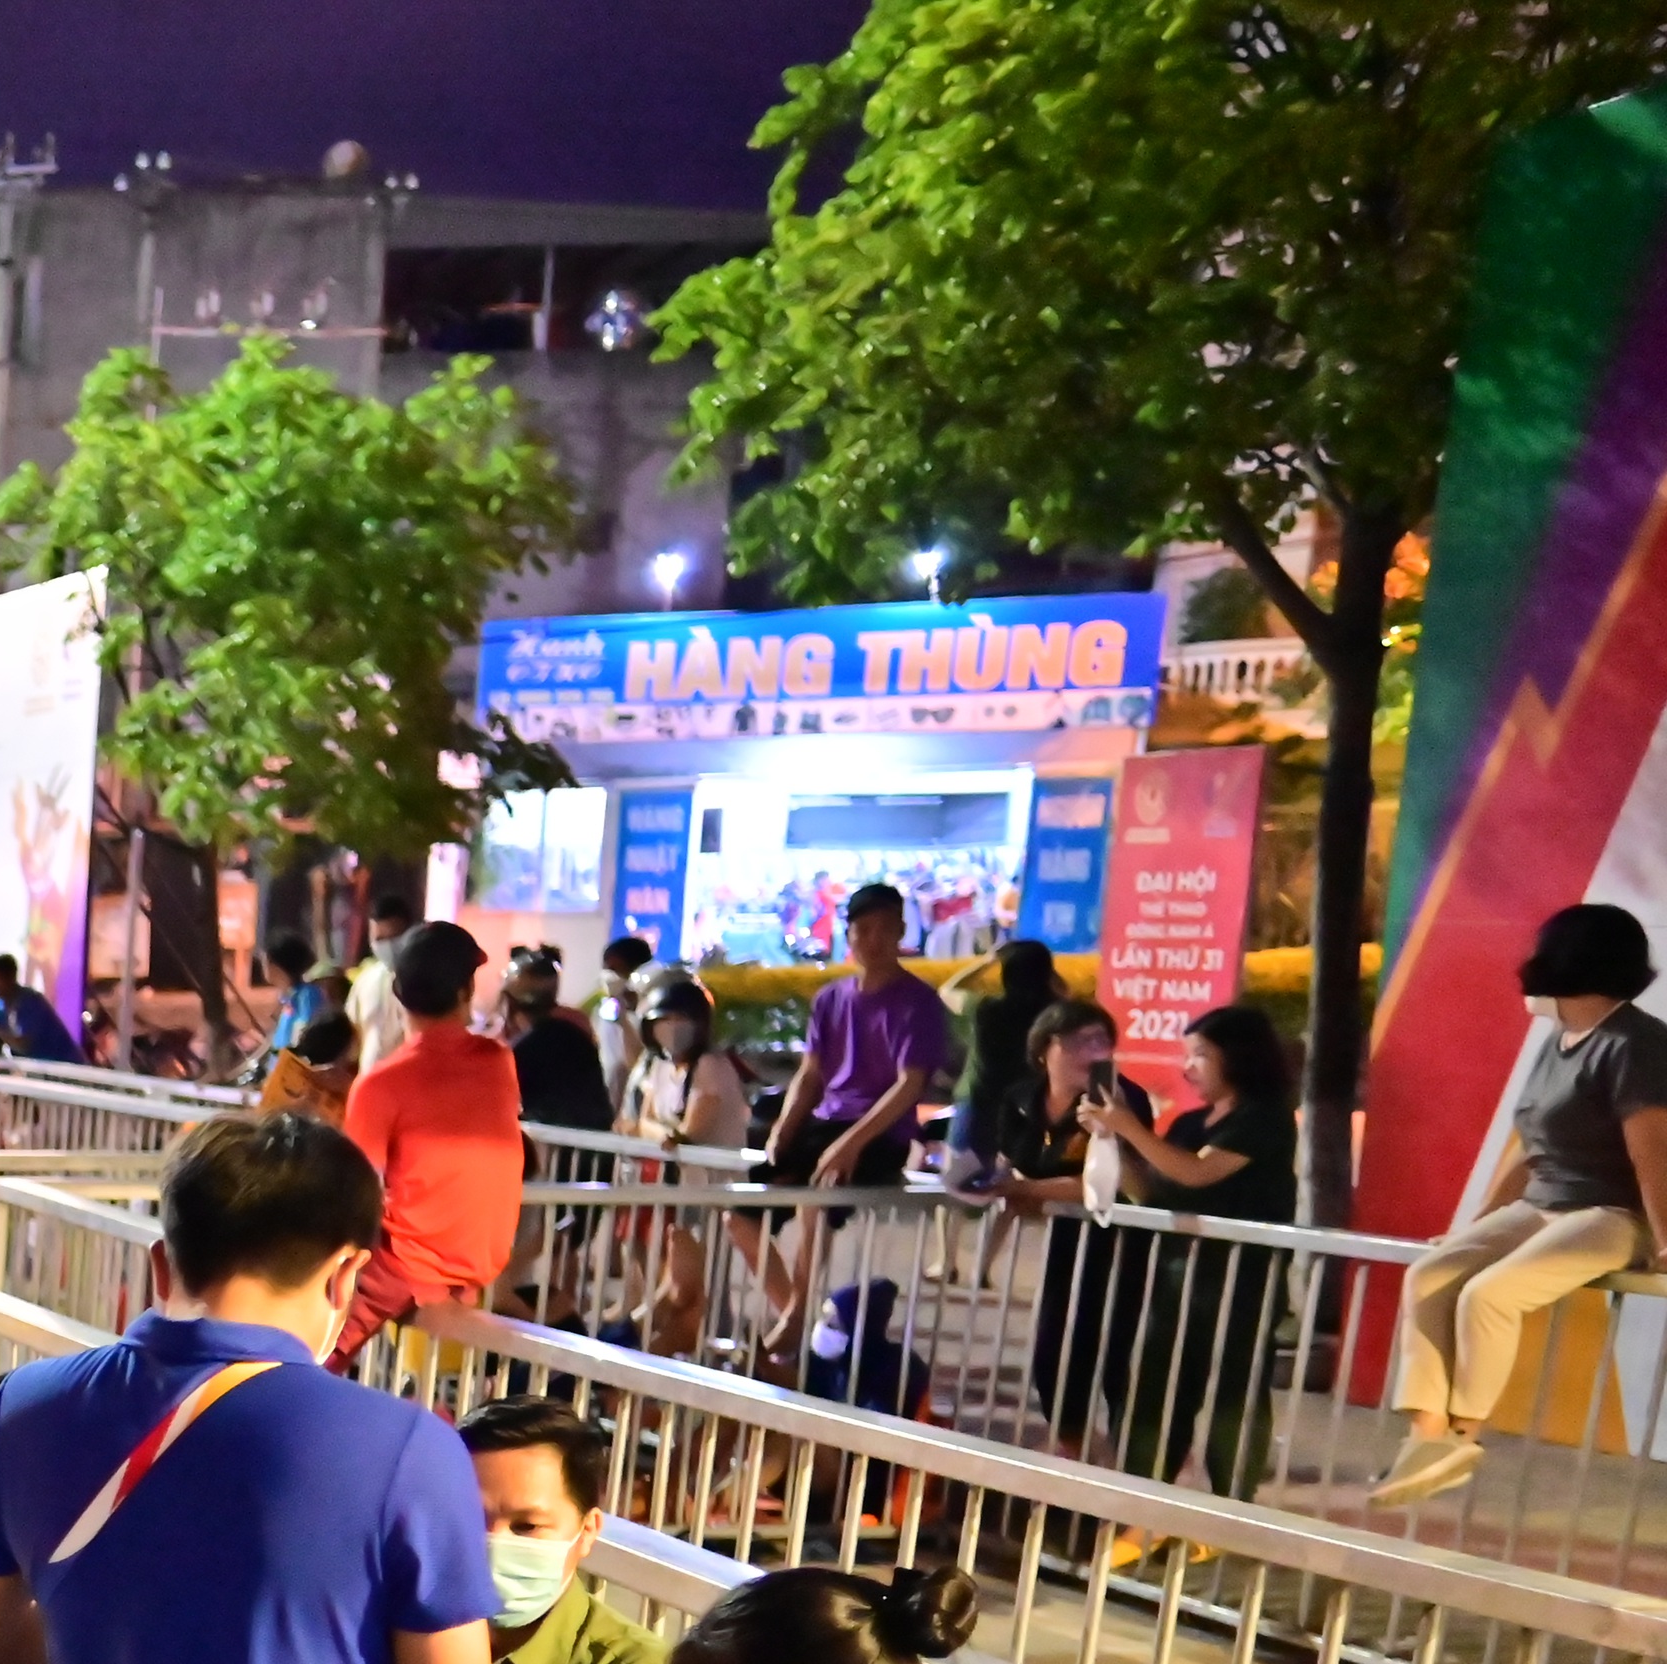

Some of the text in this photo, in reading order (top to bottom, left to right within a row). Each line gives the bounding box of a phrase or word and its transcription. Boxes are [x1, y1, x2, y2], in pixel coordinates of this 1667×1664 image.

[626, 614, 1127, 699] HÀNG THÙNG
[1176, 864, 1217, 898] HỘI
[1110, 942, 1225, 971] LẦN THỨ 31
[1112, 975, 1212, 1004] VIỆT NAM
[1125, 1008, 1190, 1041] 2021
